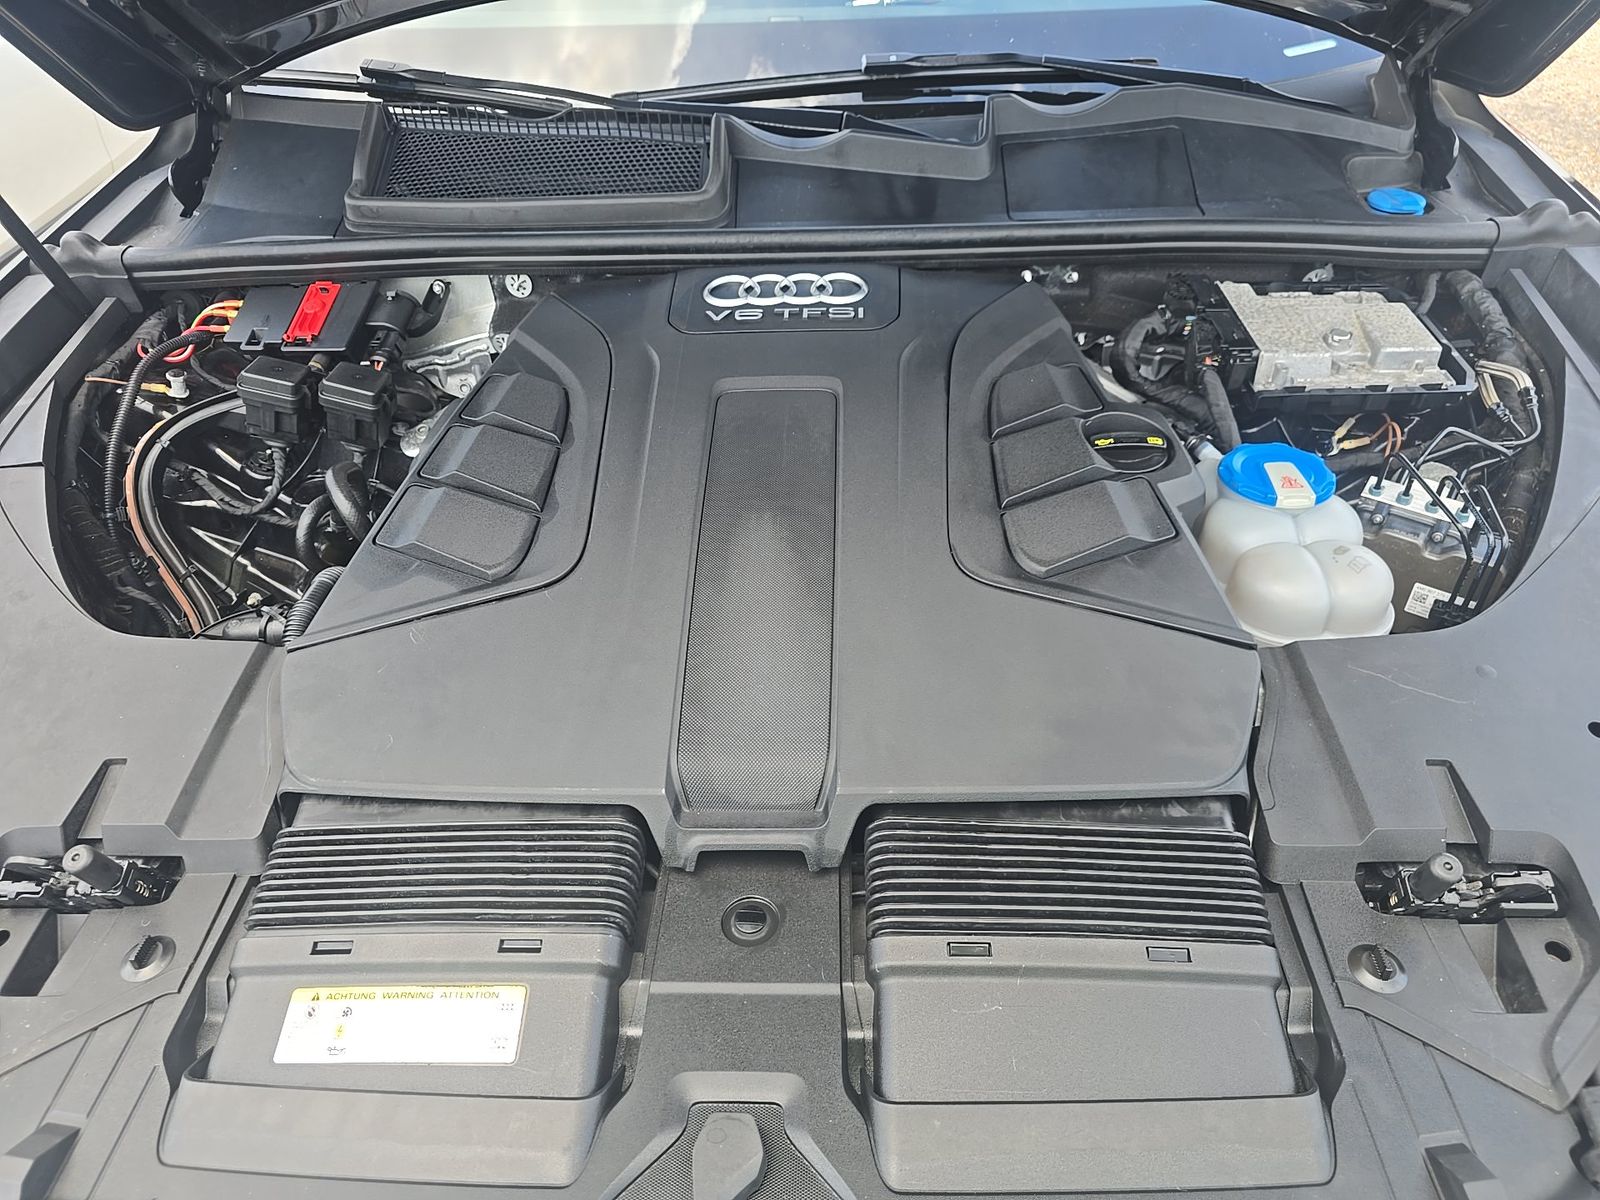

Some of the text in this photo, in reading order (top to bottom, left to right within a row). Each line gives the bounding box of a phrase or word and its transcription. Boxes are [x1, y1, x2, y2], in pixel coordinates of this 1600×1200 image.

[706, 307, 864, 321] V6 TFSI
[326, 990, 500, 1000] ACHTUNG WARNING ATTENTION
